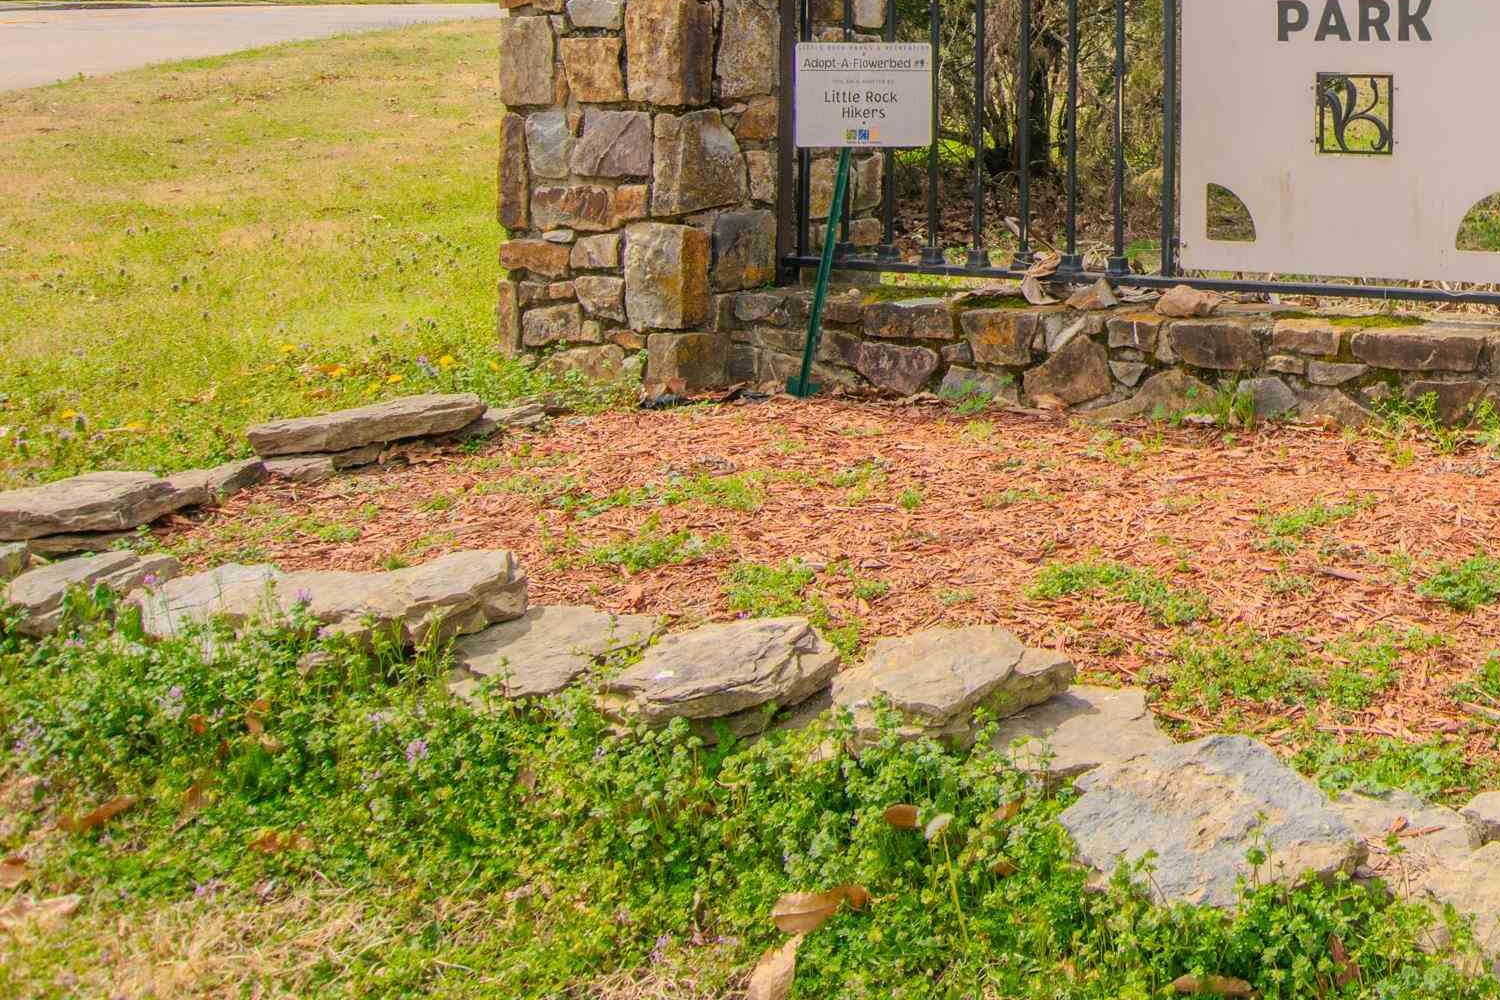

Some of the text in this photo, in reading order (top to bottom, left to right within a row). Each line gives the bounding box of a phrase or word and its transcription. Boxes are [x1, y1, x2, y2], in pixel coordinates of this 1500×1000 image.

[803, 57, 912, 70] Adopt-A-Flowerbed
[824, 90, 898, 103] Little Rock
[841, 105, 886, 119] Hikers
